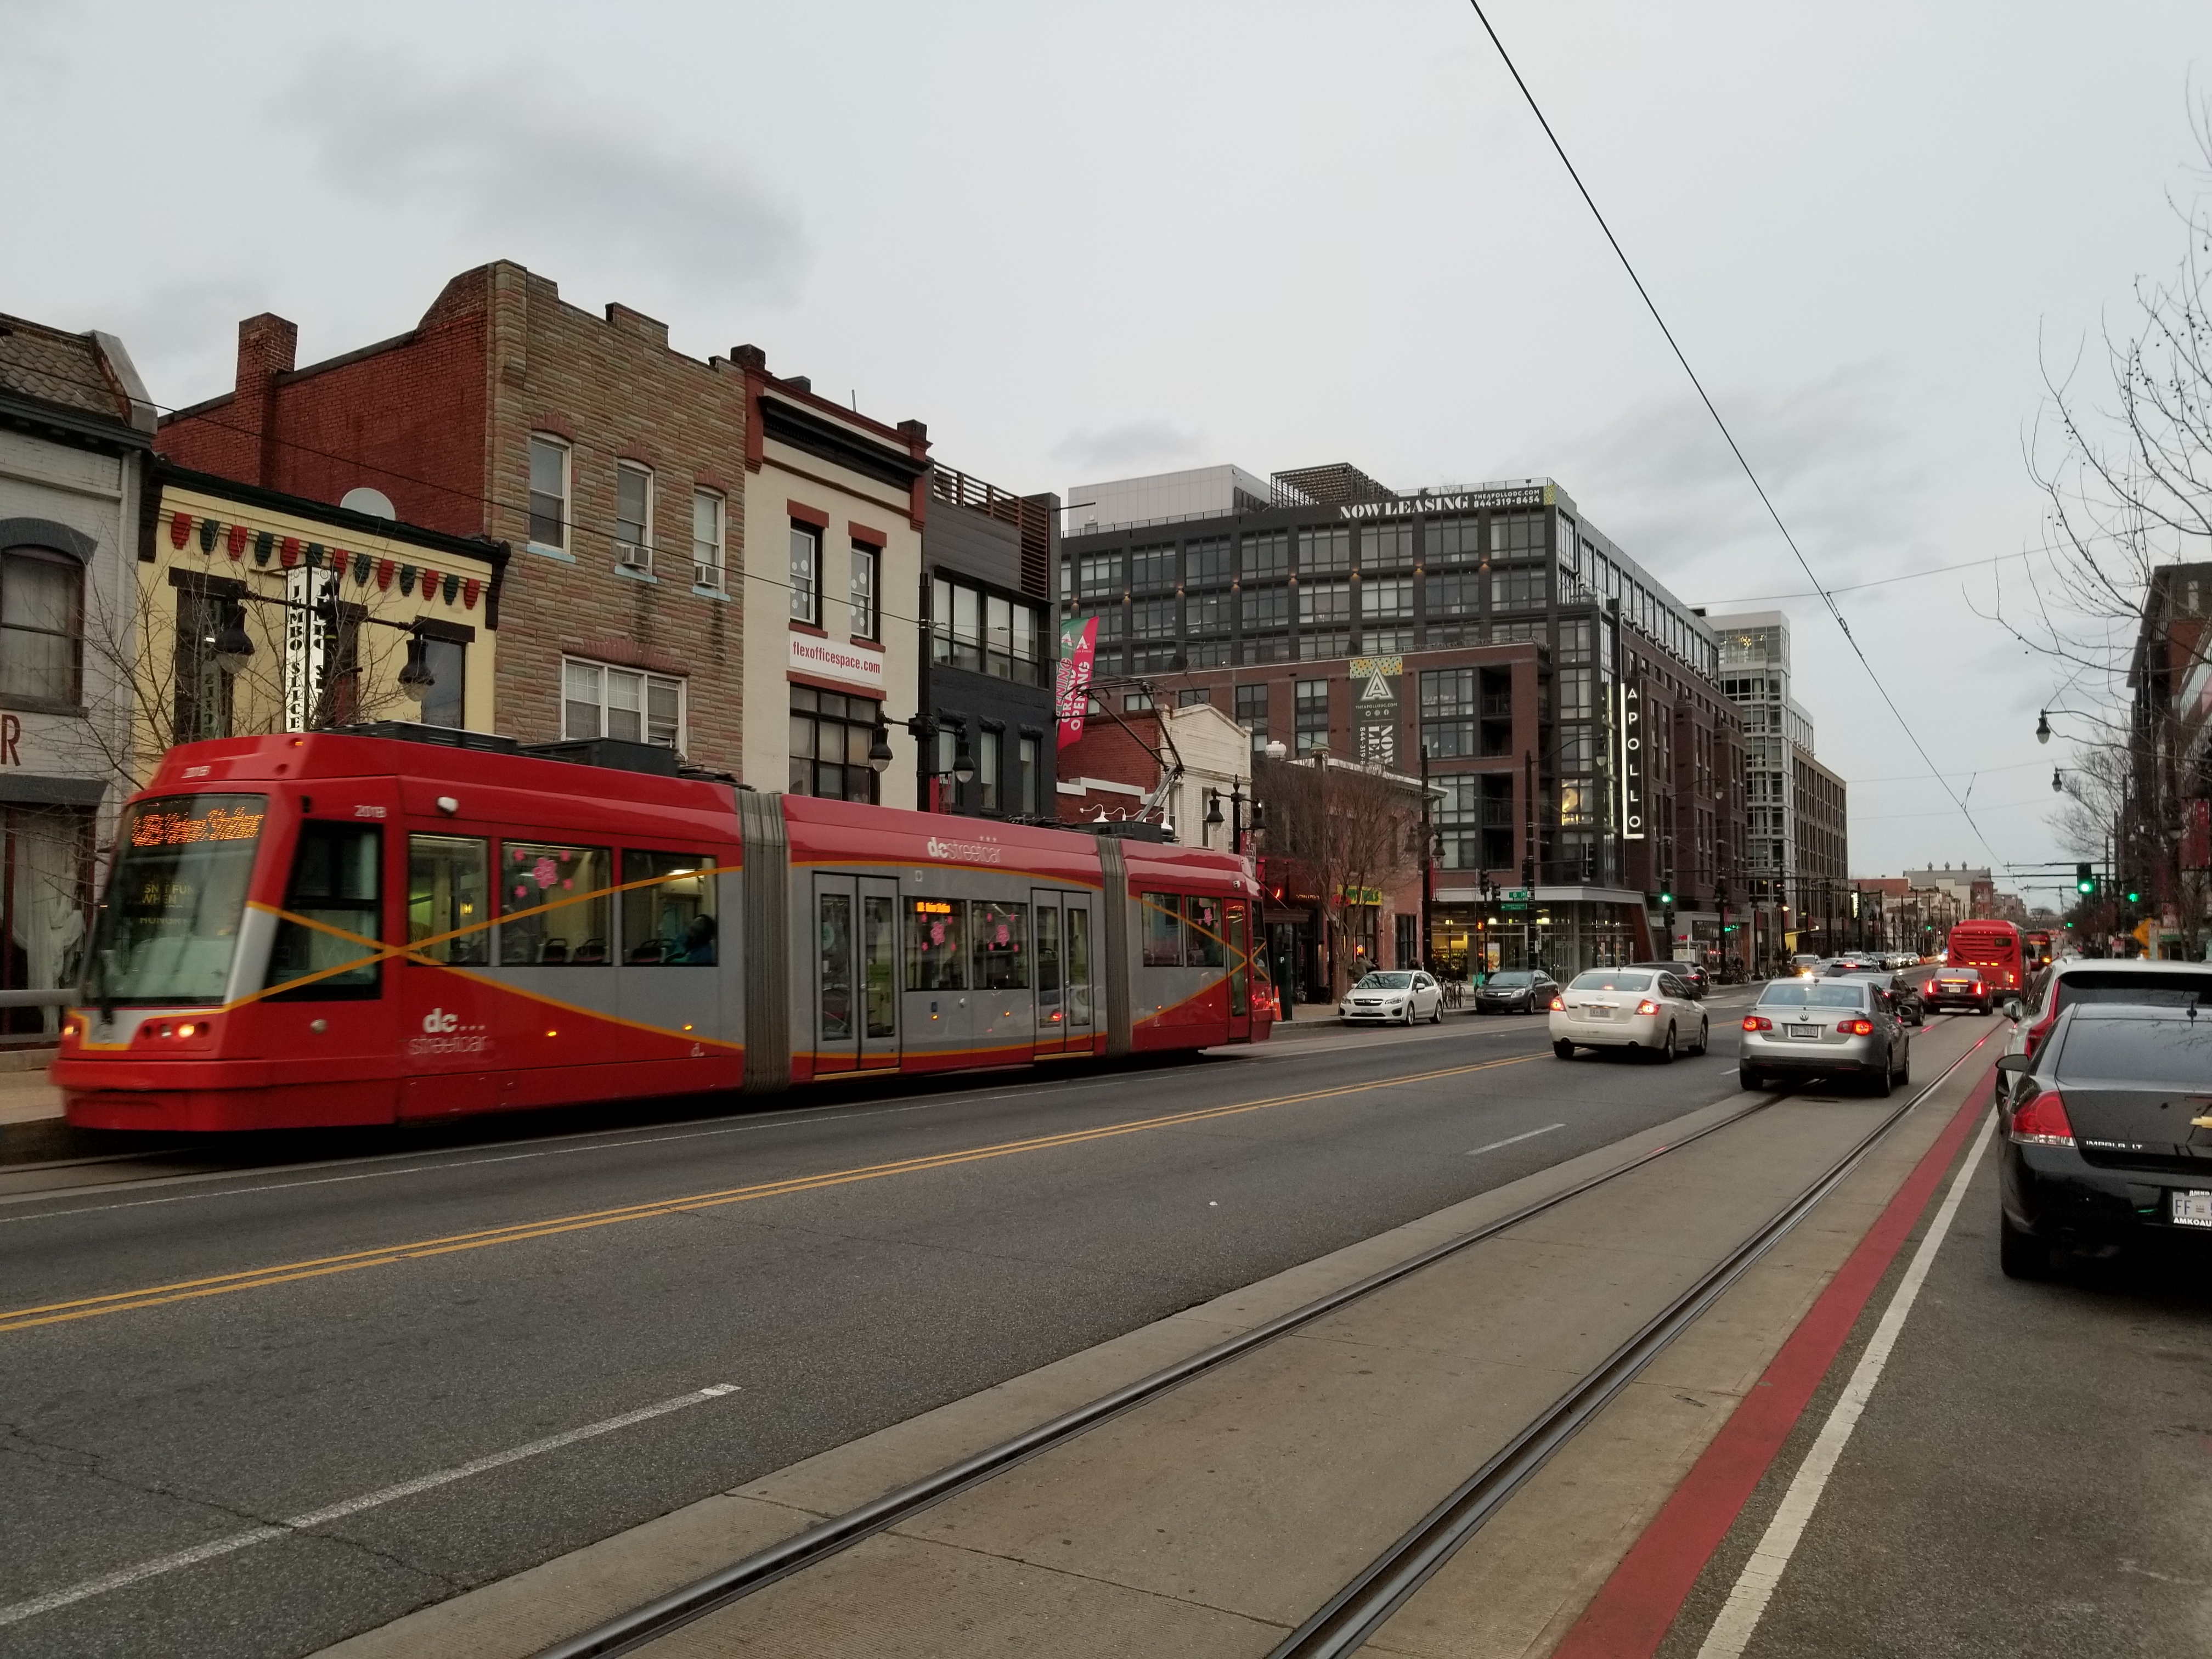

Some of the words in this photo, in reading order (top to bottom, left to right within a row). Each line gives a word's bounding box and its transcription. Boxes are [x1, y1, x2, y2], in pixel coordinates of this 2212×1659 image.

[1340, 504, 1381, 519] NOW
[1385, 496, 1469, 515] LEASING
[1474, 489, 1539, 500] THEAPOLLODC.COM
[289, 585, 303, 651] JUMBO
[793, 641, 880, 674] flexofficespace.com
[289, 662, 301, 729] SLICE
[1628, 688, 1640, 828] APOLLO
[2175, 1199, 2192, 1215] FF
